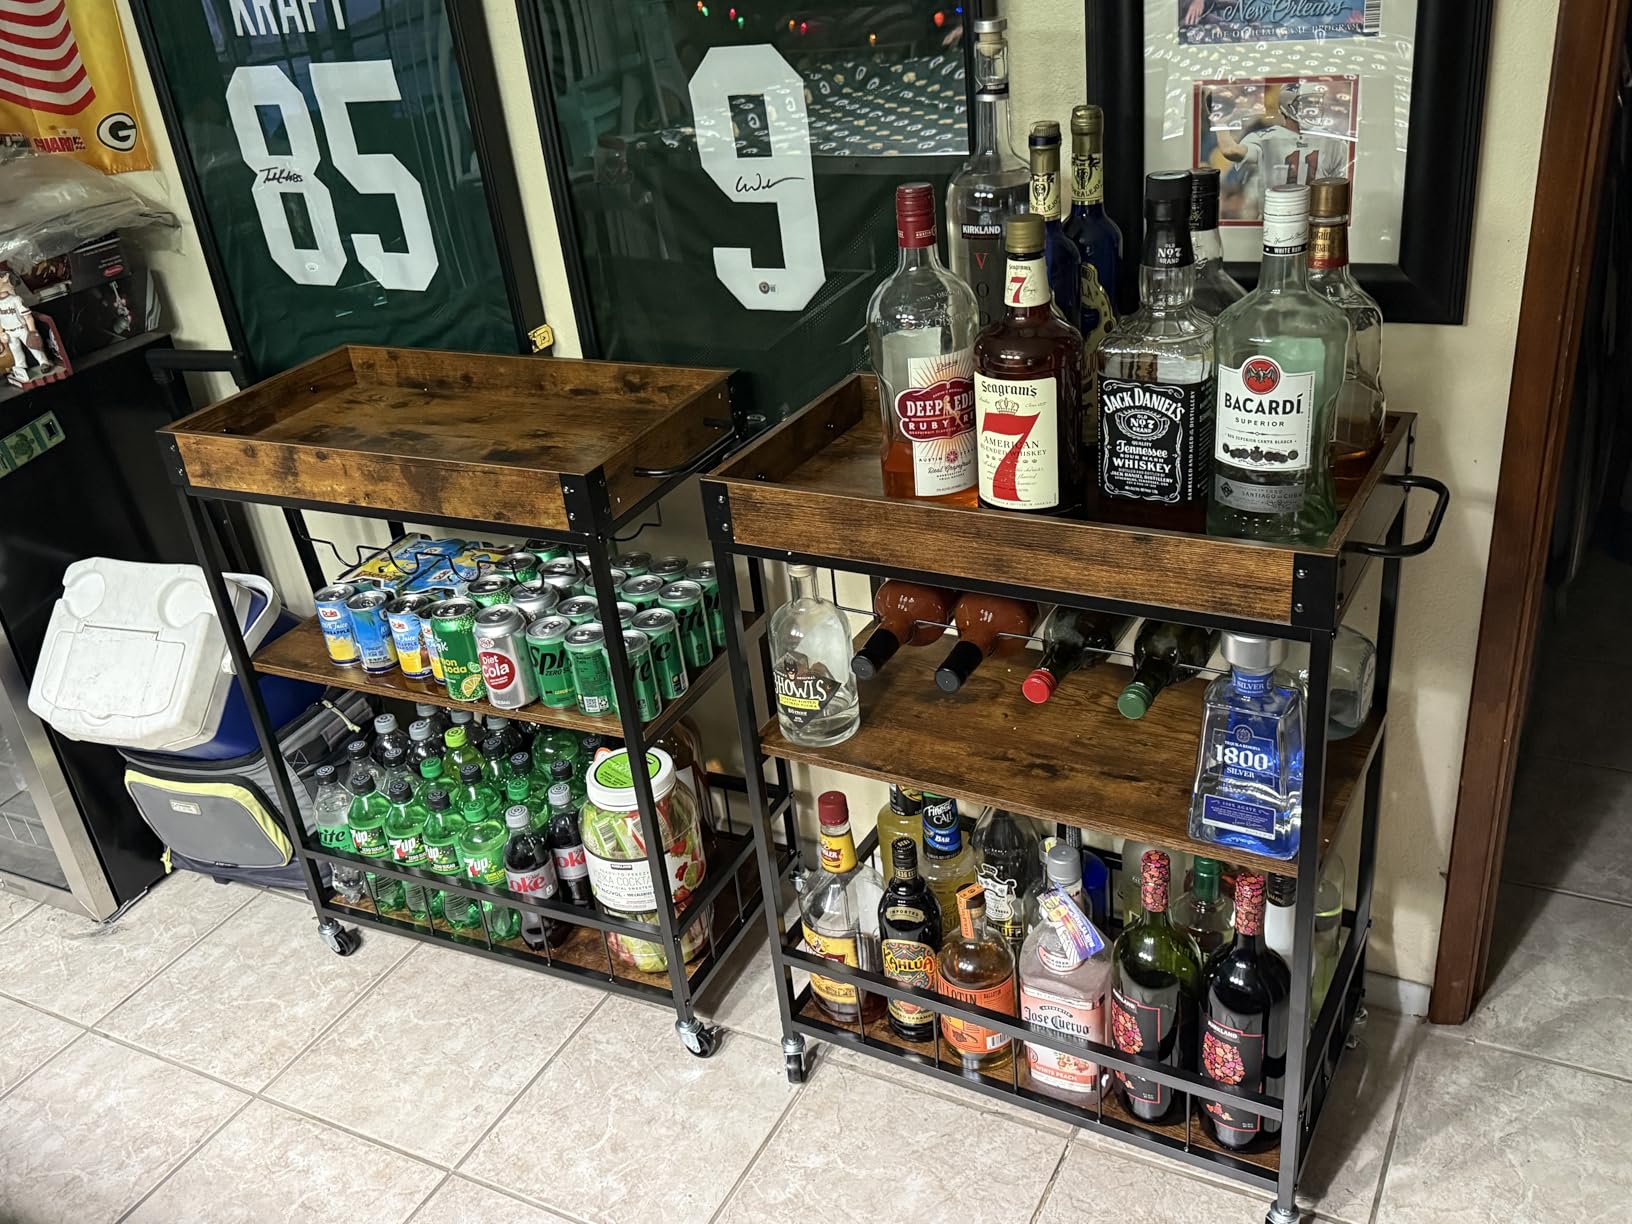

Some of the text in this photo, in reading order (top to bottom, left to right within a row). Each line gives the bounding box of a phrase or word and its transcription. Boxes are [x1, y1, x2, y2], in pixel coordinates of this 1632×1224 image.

[226, 59, 439, 292] 85
[688, 43, 826, 311] 9
[962, 224, 1001, 235] KIRKLAND
[1010, 276, 1027, 304] 7
[981, 380, 1038, 398] Seagram's
[906, 400, 944, 416] DEEP
[1103, 387, 1185, 422] JACK DANIEL'S
[1224, 392, 1304, 416] BACARDÍ
[908, 420, 949, 431] RUBY
[1235, 417, 1285, 428] SUPERIOR
[983, 436, 1040, 450] AMERICAN
[1116, 439, 1169, 458] Tennessee
[982, 409, 1041, 502] 7
[1112, 457, 1172, 473] WHISKEY
[482, 655, 499, 664] Diet
[482, 662, 510, 678] Cola
[1237, 680, 1264, 690] SILVER
[1215, 744, 1269, 771] 1800
[1226, 767, 1255, 779] SILVER
[389, 837, 416, 860] 7up
[463, 858, 488, 878] 7up
[882, 946, 935, 973] KAHLÚA
[1024, 1006, 1049, 1024] Jose
[1051, 1014, 1090, 1035] Cuervo
